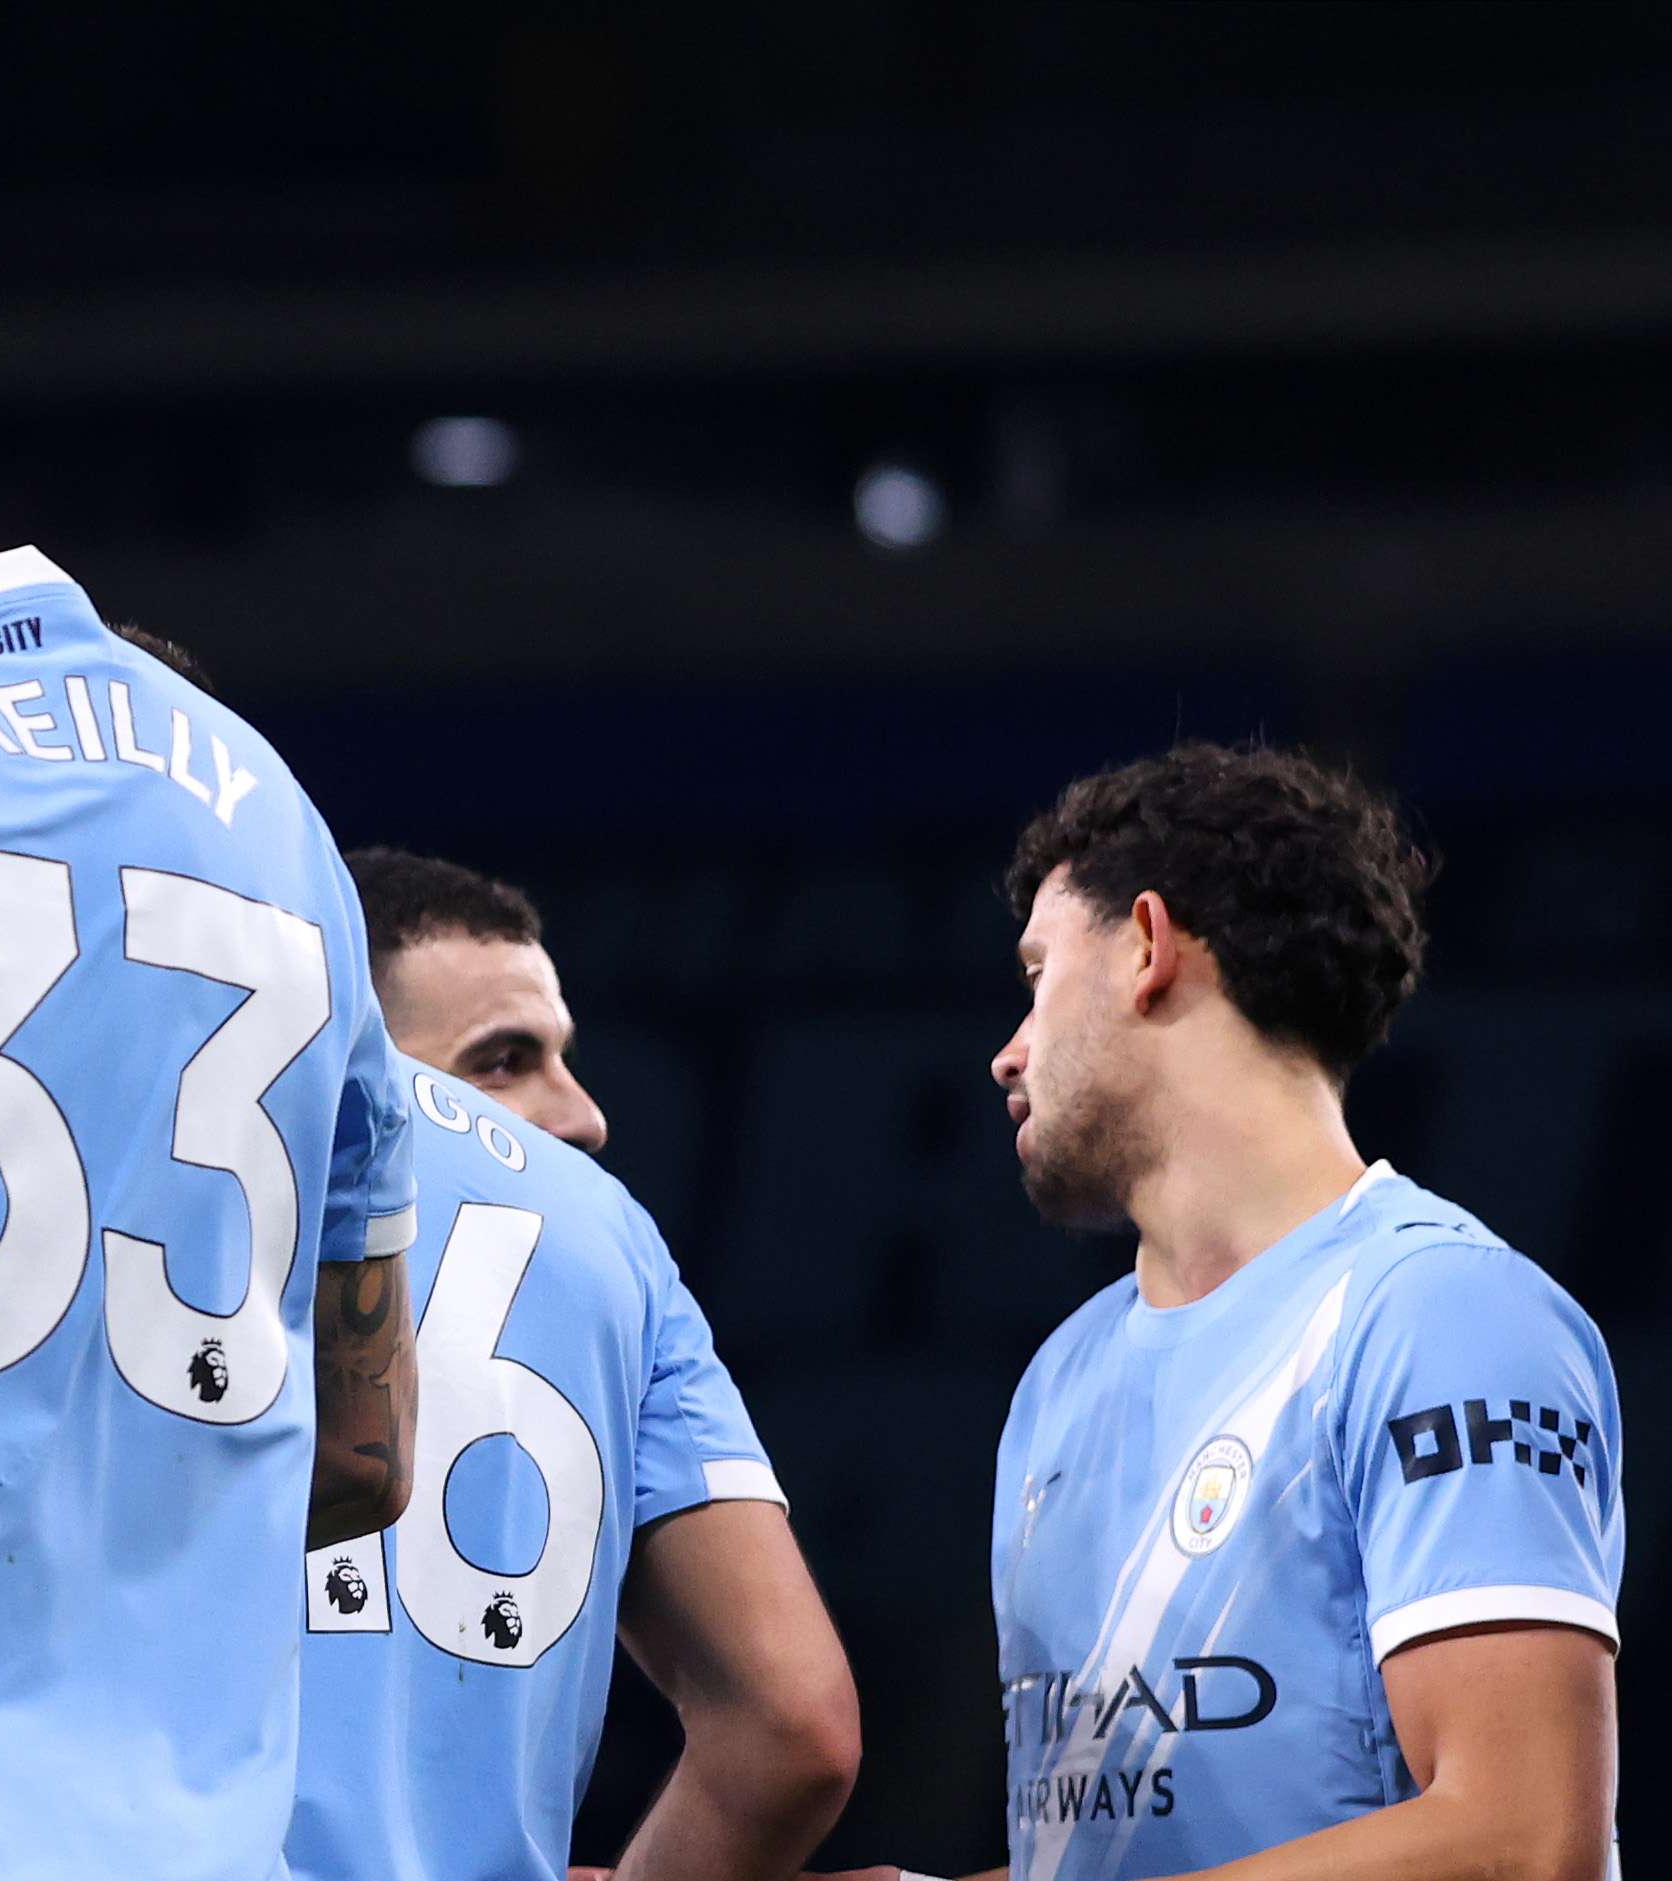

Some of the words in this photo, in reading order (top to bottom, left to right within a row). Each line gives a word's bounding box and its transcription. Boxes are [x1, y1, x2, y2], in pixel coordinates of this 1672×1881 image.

[1388, 1398, 1591, 1487] OKX
[1003, 1655, 1277, 1748] TIHAD
[1016, 1767, 1176, 1829] AIRWAYS
